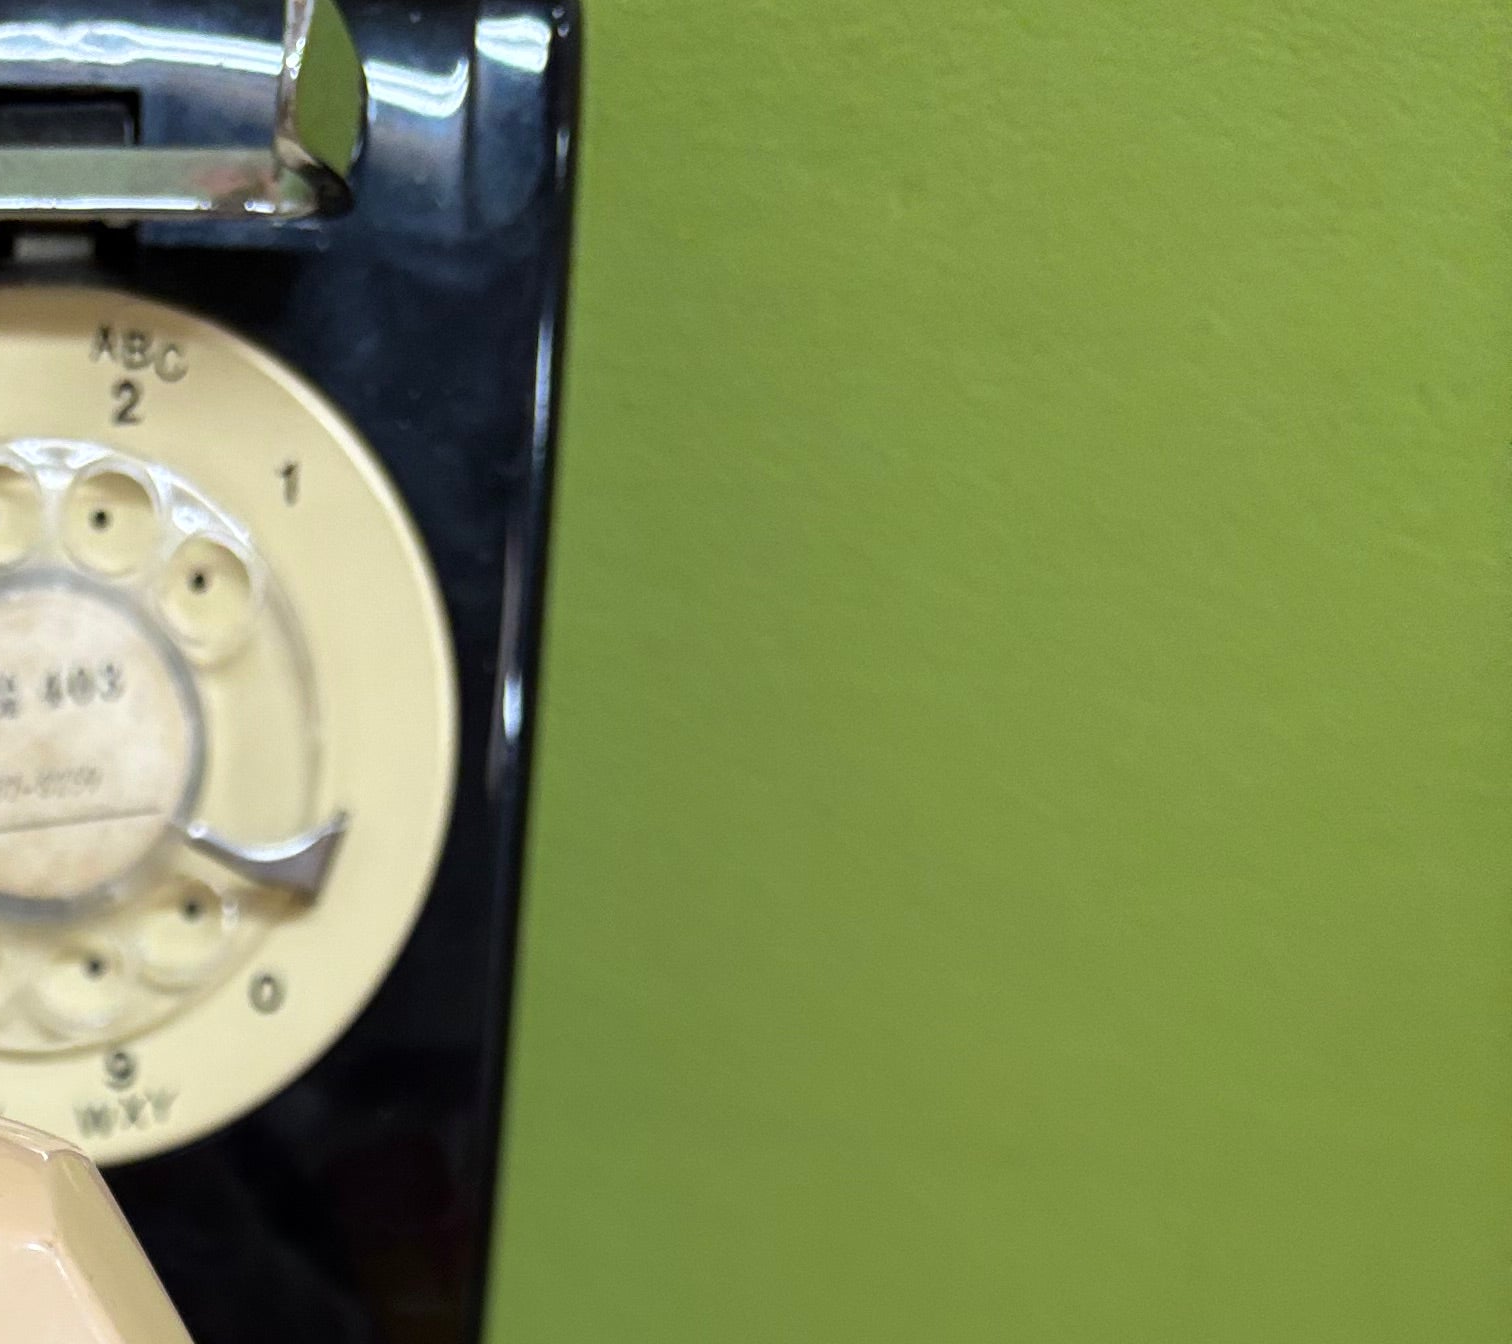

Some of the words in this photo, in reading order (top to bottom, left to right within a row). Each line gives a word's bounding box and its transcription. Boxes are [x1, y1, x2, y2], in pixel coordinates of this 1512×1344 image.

[90, 322, 189, 383] ABC
[110, 378, 144, 426] 2
[276, 458, 300, 506] 1
[248, 967, 287, 1015] 0
[104, 1048, 138, 1092] 9
[72, 1083, 180, 1141] WXY
